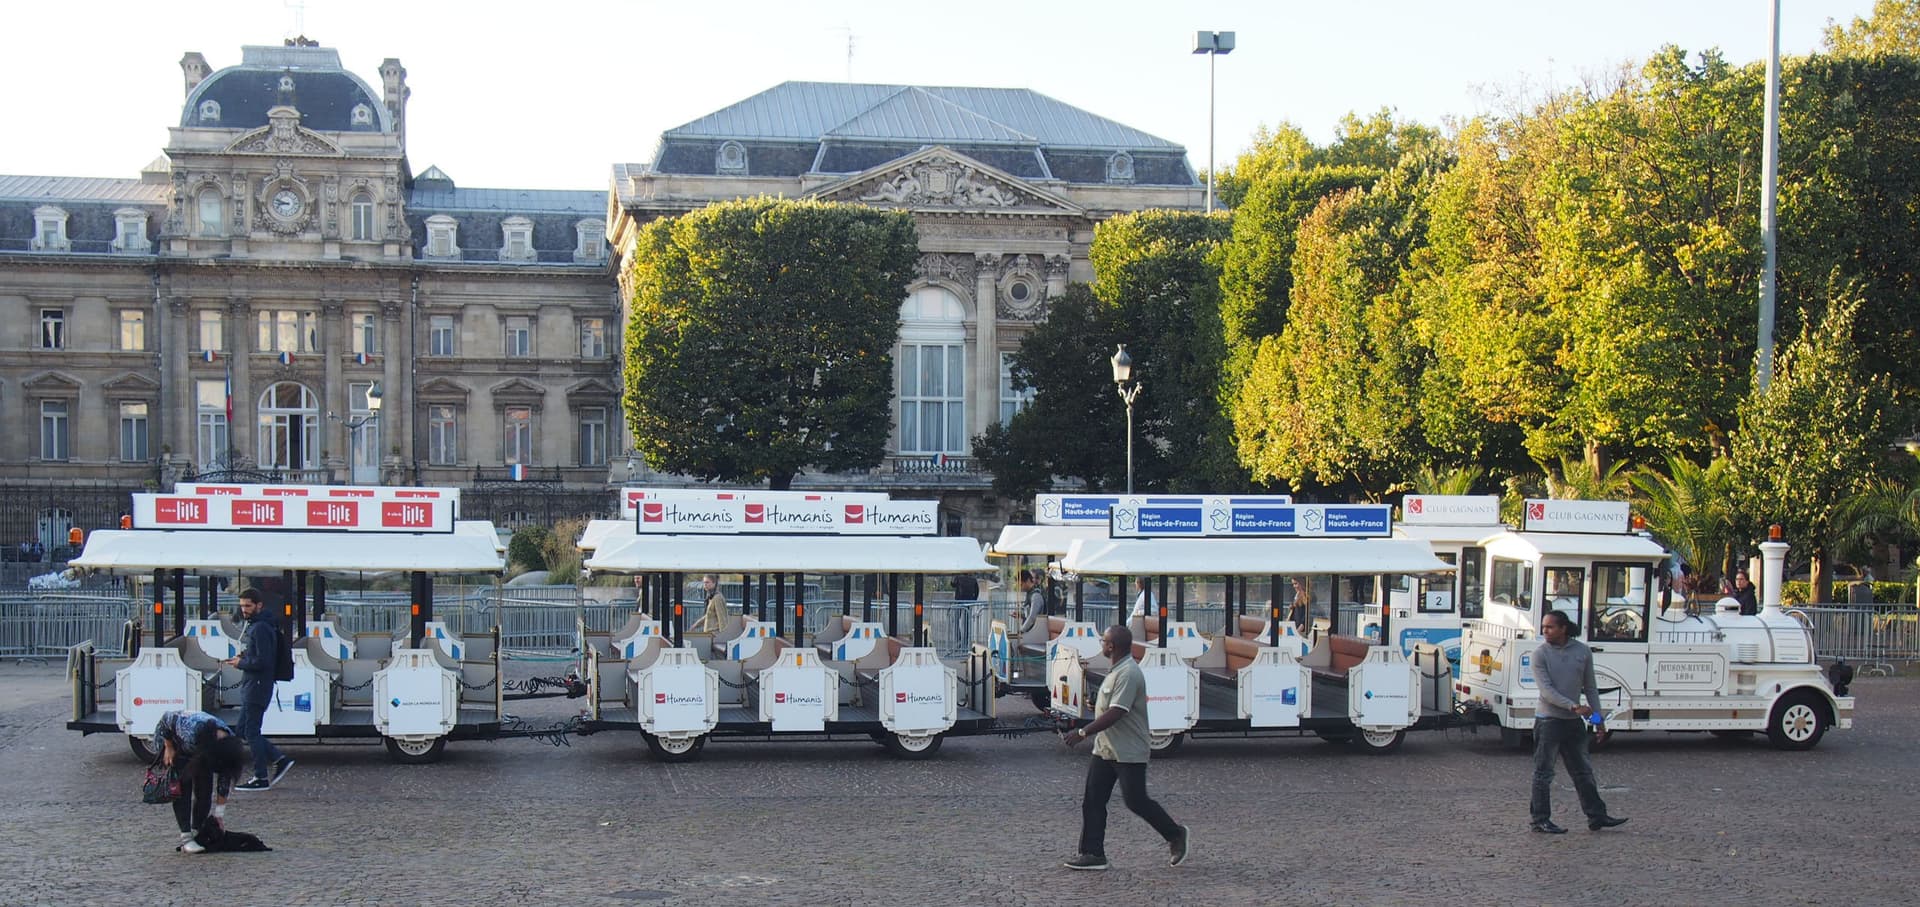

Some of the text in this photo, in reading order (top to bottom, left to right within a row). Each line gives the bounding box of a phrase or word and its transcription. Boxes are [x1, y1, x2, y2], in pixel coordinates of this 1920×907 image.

[666, 503, 732, 524] Humanis
[1064, 508, 1110, 516] Hauts-de-Fran
[1426, 505, 1495, 513] CLUB GAGNANTS
[766, 504, 832, 525] Humanis
[866, 505, 932, 526] Humanis
[1549, 511, 1624, 522] CLUB GAGNANTS
[1142, 520, 1198, 528] Hauts-de-France
[1236, 520, 1292, 528] Hauts-de-France
[1328, 520, 1384, 528] Hauts-de-France
[1436, 596, 1442, 606] 2
[667, 694, 703, 704] Humanis
[786, 694, 822, 704] Humanis
[908, 692, 942, 703] Humanis
